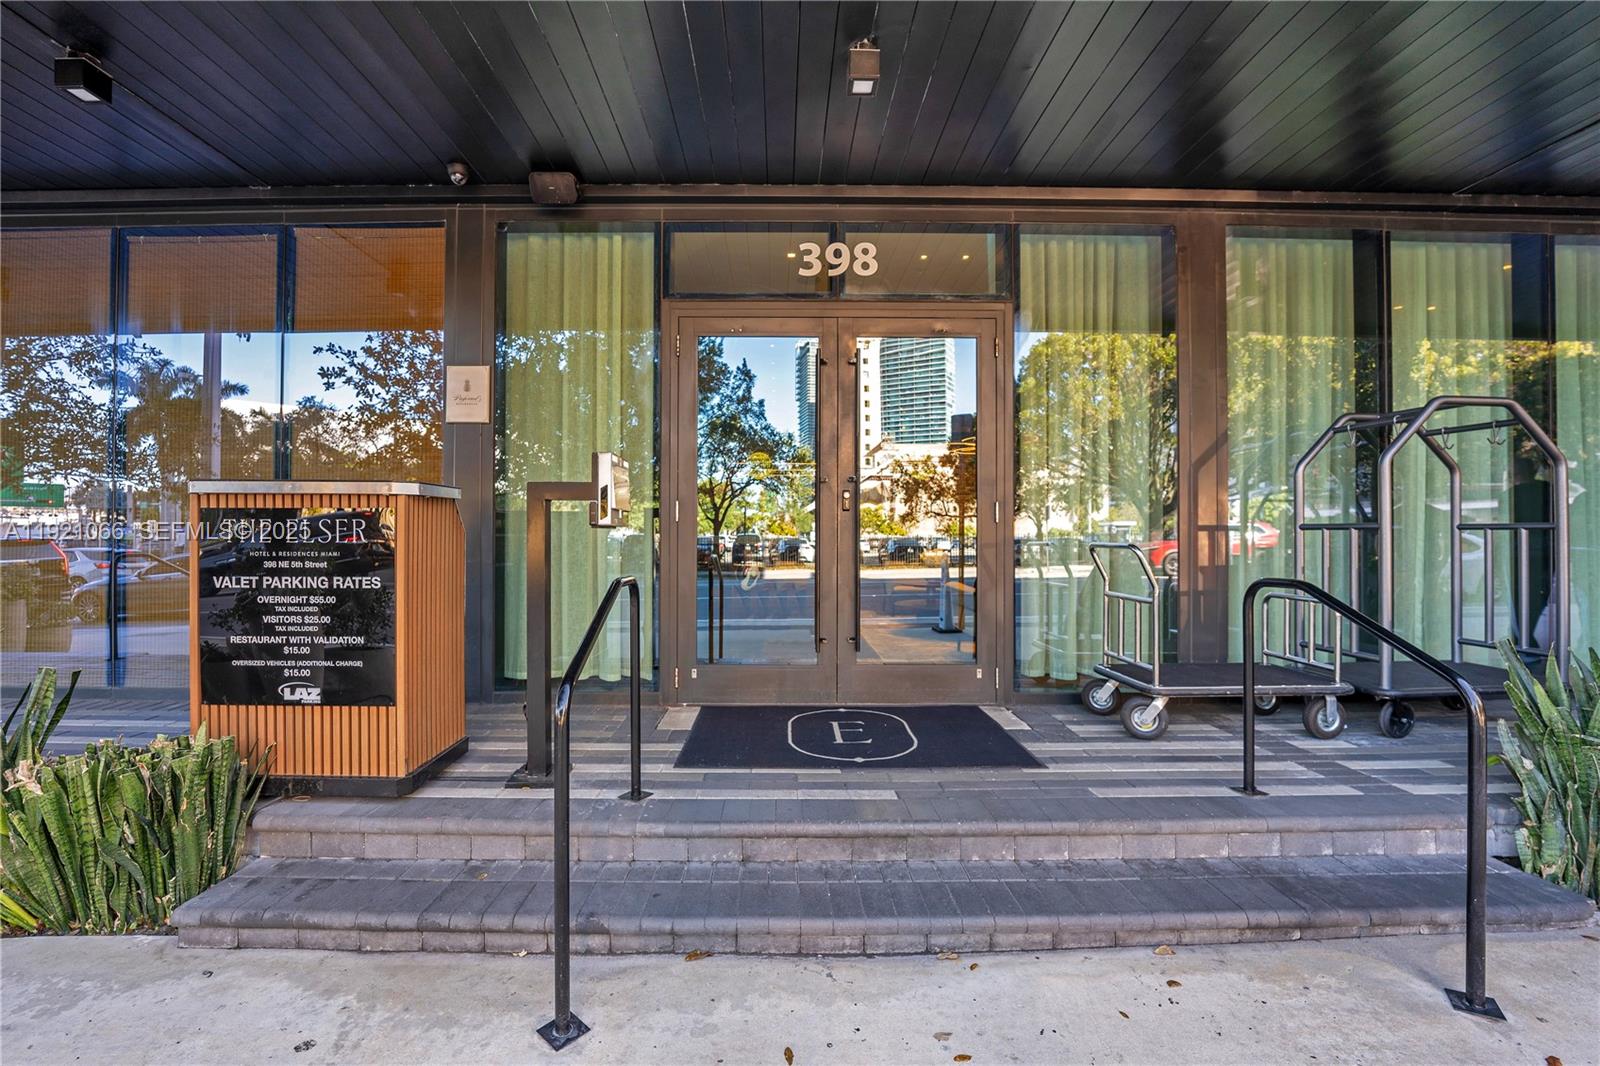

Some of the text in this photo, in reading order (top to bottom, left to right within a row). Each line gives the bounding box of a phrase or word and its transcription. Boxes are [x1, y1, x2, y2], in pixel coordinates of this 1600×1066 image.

[798, 241, 879, 277] 398
[223, 518, 368, 543] THE ELSER
[263, 561, 277, 569] 398
[304, 560, 328, 568] Street
[212, 576, 382, 589] VALET PARKING RATES
[257, 595, 337, 605] OVERNIGHT $55.00
[262, 615, 331, 625] VISITORS $25.00
[230, 636, 365, 644] RESTAURANT WITH VALIDATION
[283, 646, 311, 655] $15.00
[296, 660, 335, 668] (ADDITIONAL
[335, 660, 363, 668] CHARGE)
[283, 668, 311, 678] $15.00
[283, 687, 321, 700] LAZ
[828, 720, 873, 744] E
